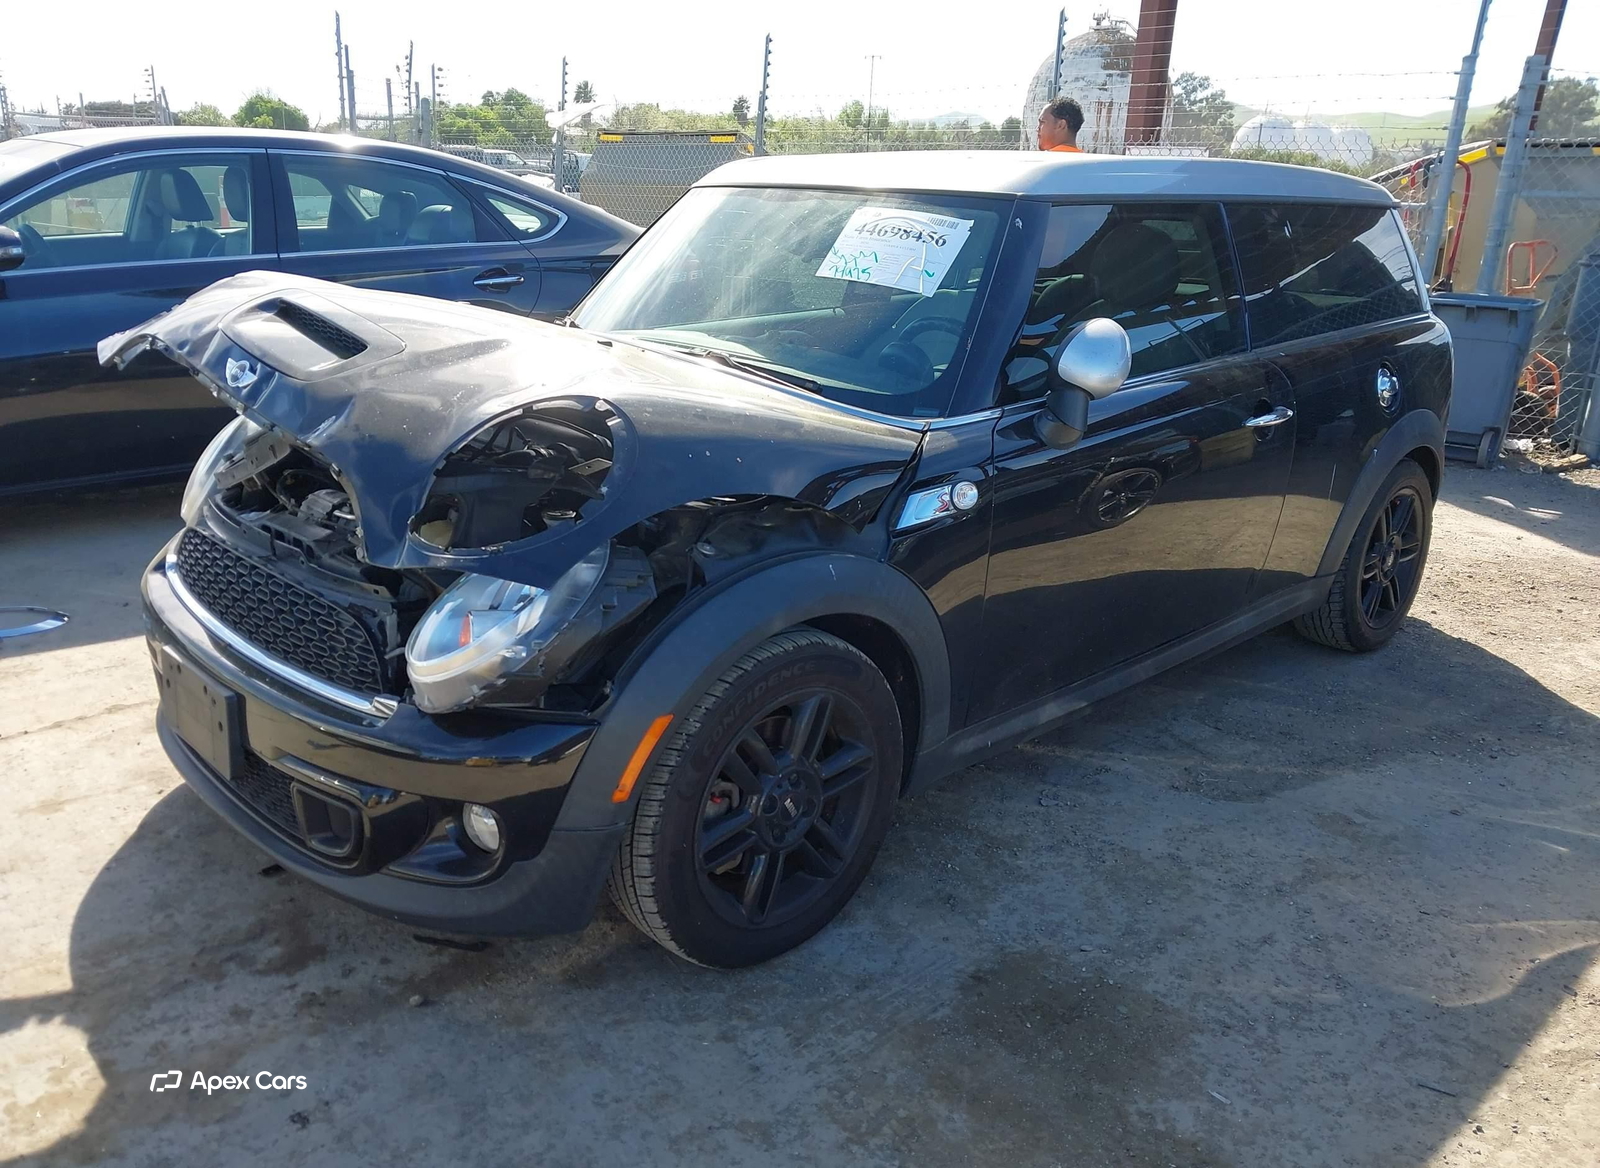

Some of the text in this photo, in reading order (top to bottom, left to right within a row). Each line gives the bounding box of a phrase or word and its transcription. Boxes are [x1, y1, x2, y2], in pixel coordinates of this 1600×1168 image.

[854, 222, 950, 247] 44698456
[932, 492, 950, 514] S
[702, 659, 818, 757] CONFIDENCE
